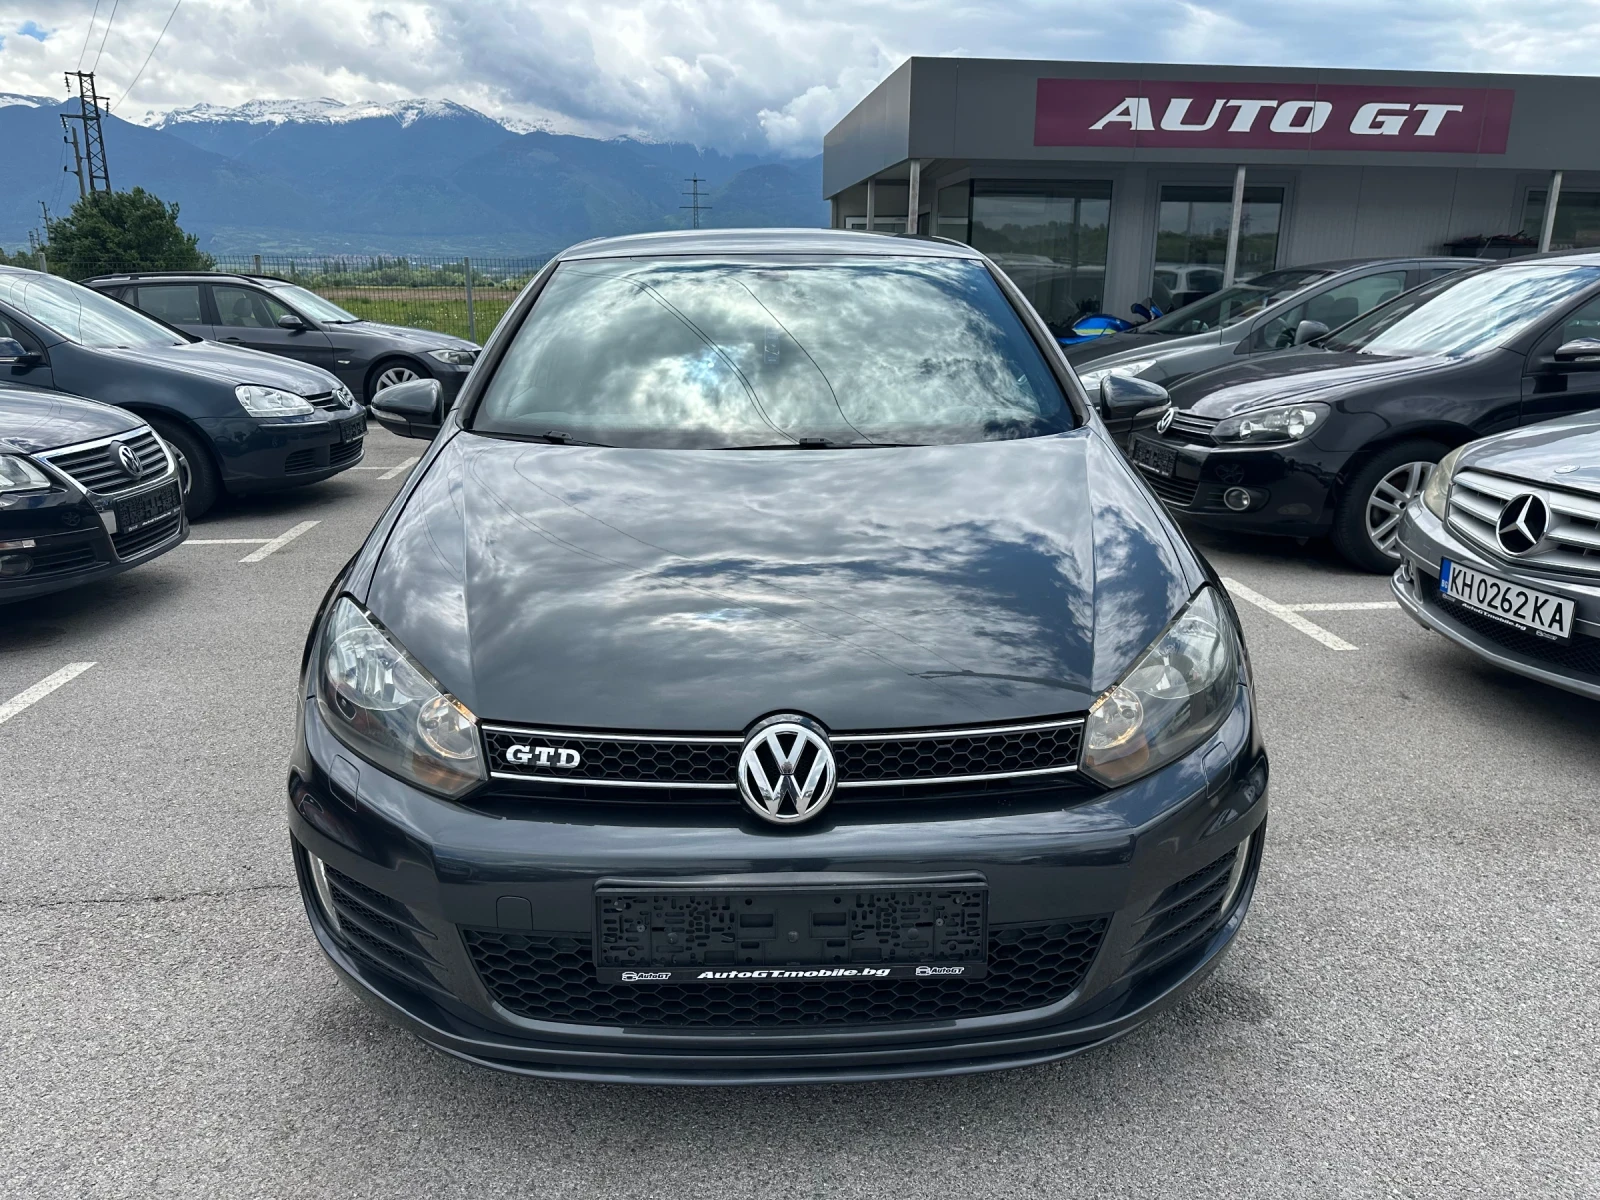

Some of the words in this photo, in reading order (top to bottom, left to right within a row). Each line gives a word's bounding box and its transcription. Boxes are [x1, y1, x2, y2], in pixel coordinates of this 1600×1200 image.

[1089, 97, 1333, 133] AUTO
[1349, 102, 1463, 136] GT
[506, 744, 581, 769] GTD
[738, 723, 836, 823] VW
[637, 972, 671, 980] AutoGT
[931, 967, 964, 975] AutoGT
